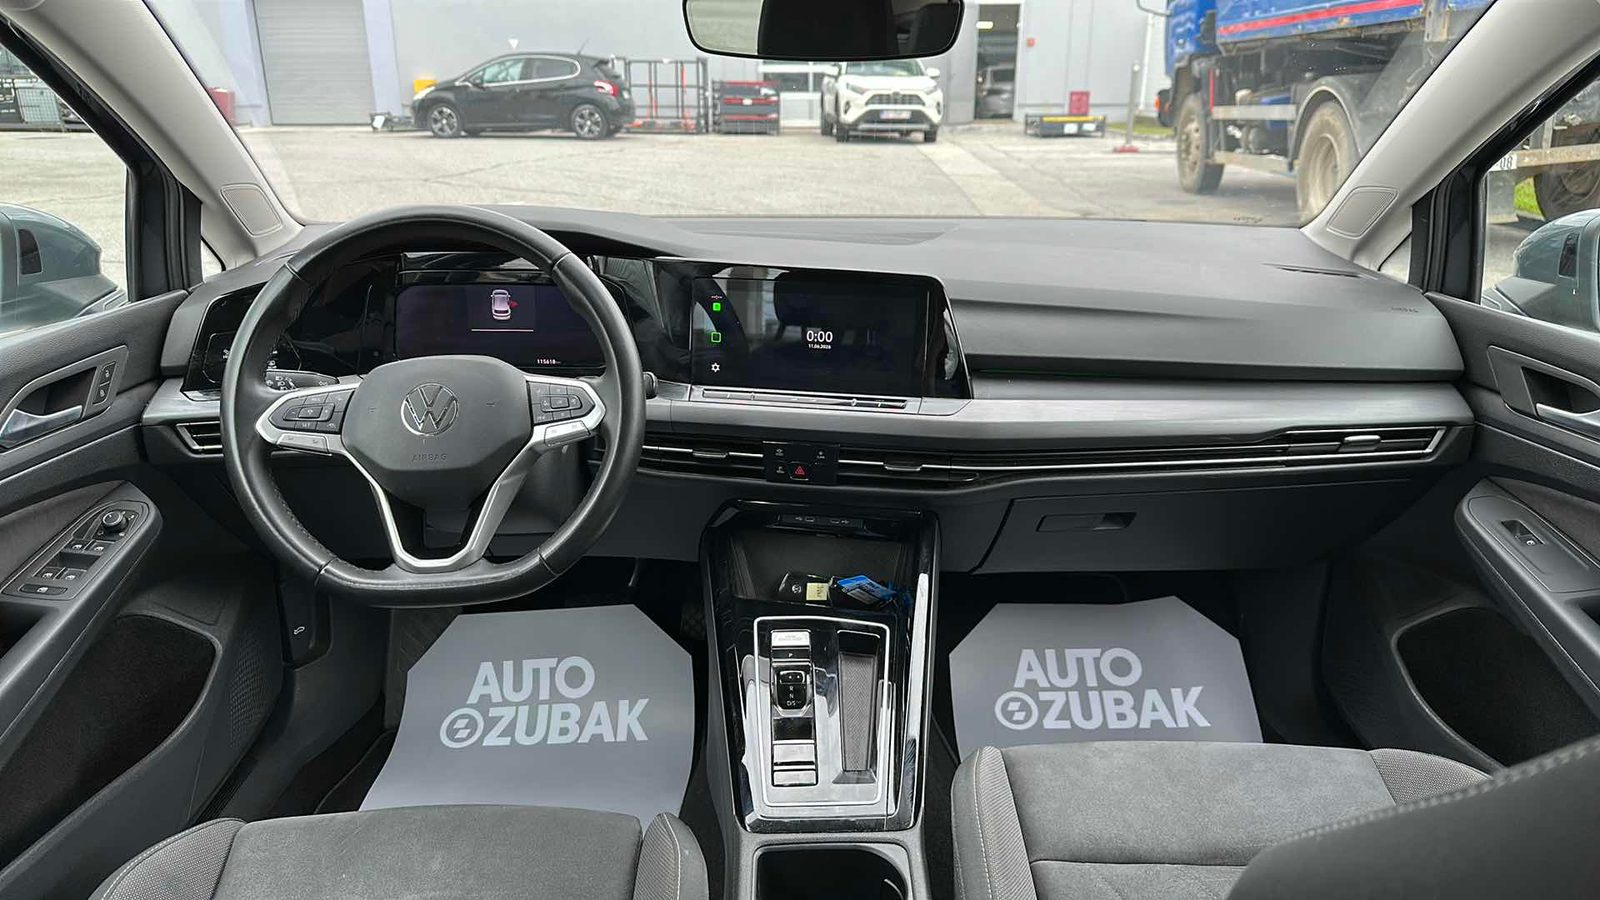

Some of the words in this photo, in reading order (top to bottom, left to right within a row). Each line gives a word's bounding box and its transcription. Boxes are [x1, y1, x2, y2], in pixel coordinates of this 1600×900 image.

[806, 330, 833, 342] 0:00
[411, 453, 448, 462] AIRBAG
[466, 655, 596, 704] AUTO
[1013, 647, 1143, 689] AUTO
[482, 698, 650, 747] ZUBAK
[1038, 685, 1212, 730] ZUBAK
